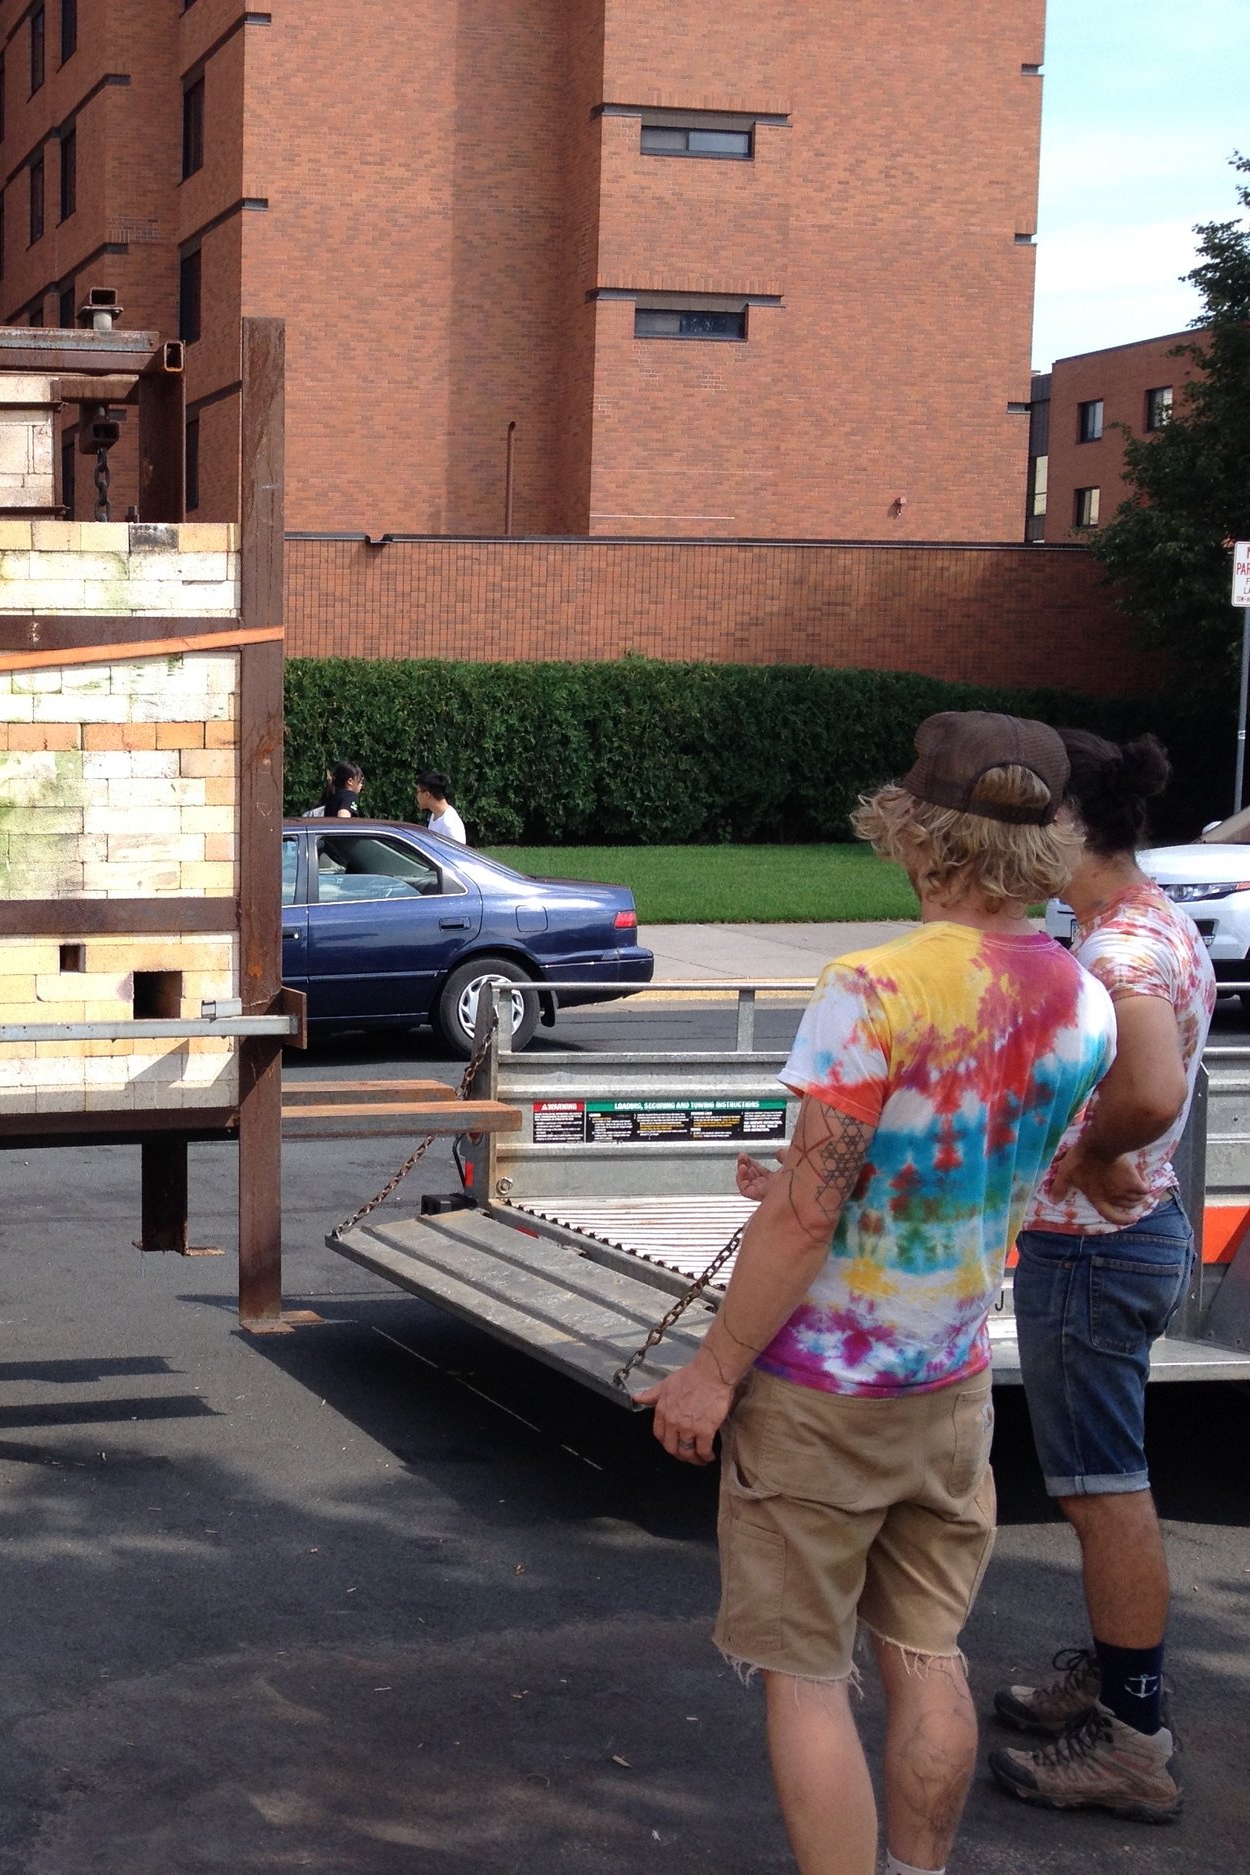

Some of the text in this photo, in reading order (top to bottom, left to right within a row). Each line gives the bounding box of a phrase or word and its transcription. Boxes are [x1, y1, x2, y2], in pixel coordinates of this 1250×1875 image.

[547, 1102, 577, 1111] WARNING
[676, 1101, 689, 1110] AND
[691, 1101, 714, 1110] TOWING
[715, 1100, 760, 1109] INSTRUCTIONS
